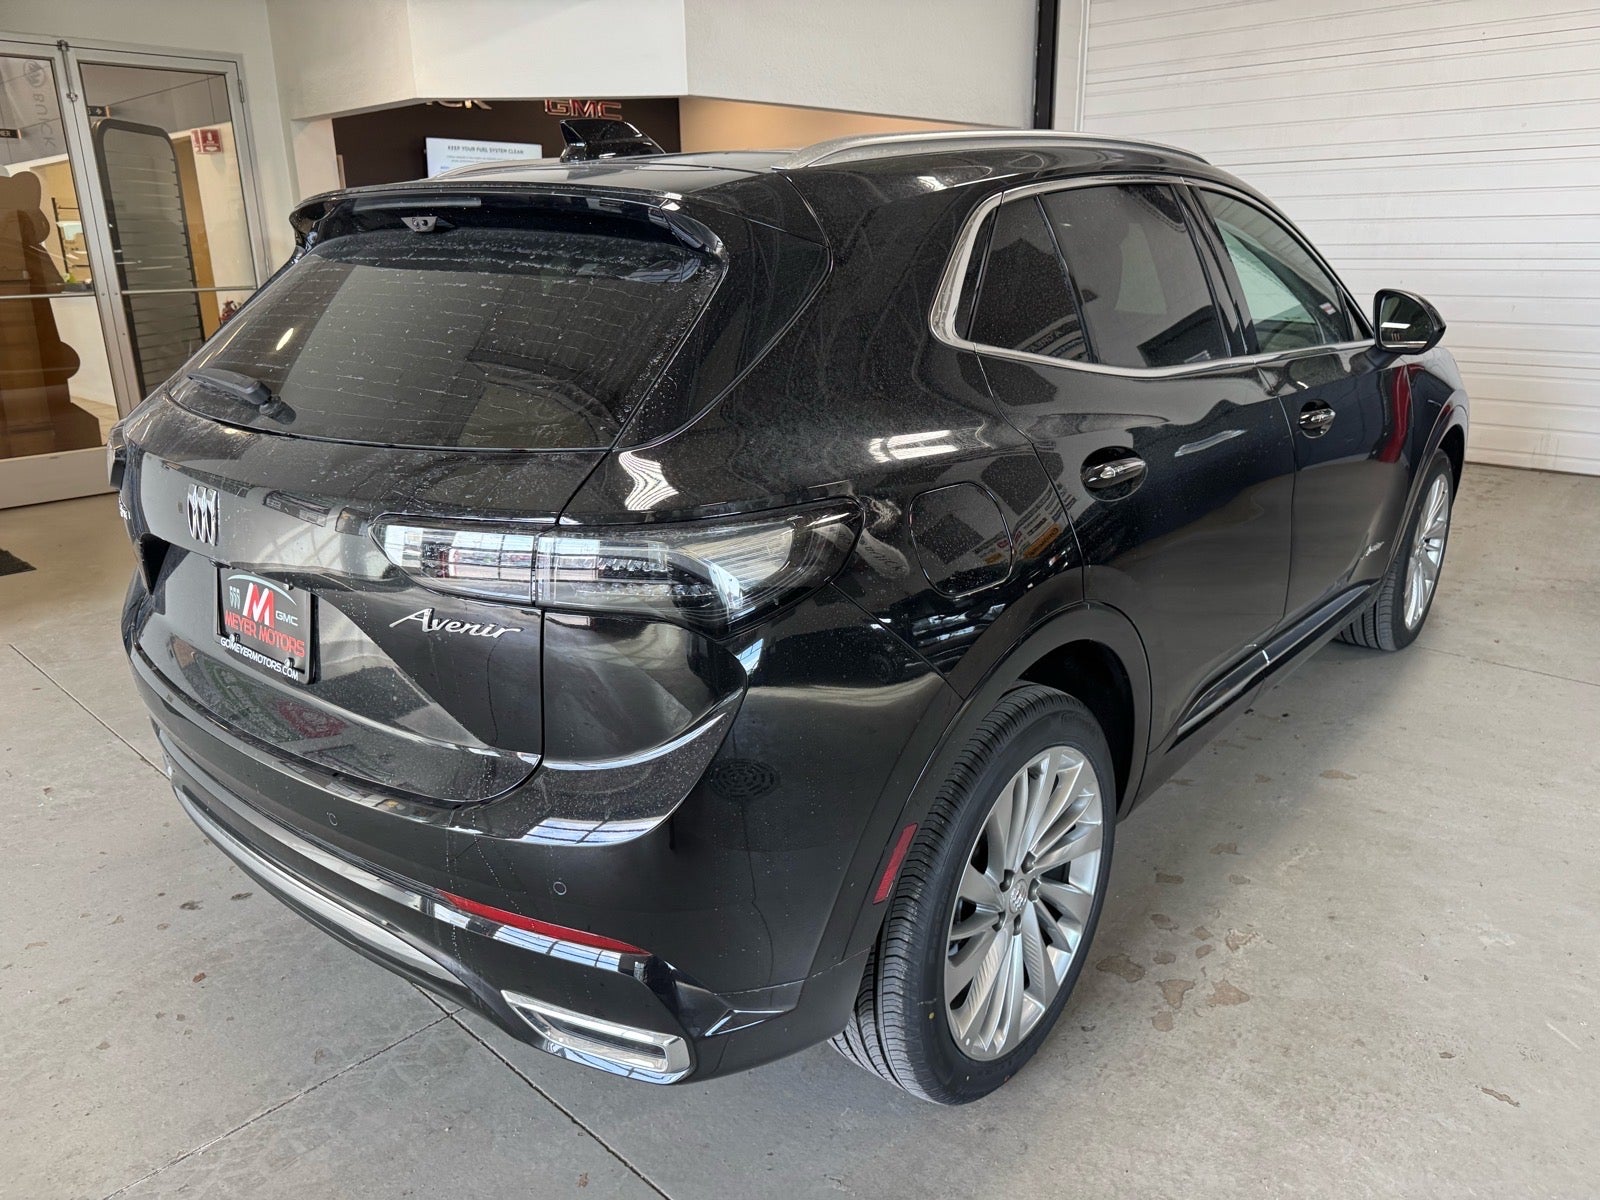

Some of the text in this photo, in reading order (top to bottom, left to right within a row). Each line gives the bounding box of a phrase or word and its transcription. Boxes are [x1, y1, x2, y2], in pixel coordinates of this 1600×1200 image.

[545, 98, 623, 121] GMC
[225, 610, 305, 657] MEYER MOTORS
[275, 610, 298, 626] GMC
[389, 607, 522, 638] Avenir
[220, 637, 299, 681] GOMEYERMOTORS.COM
